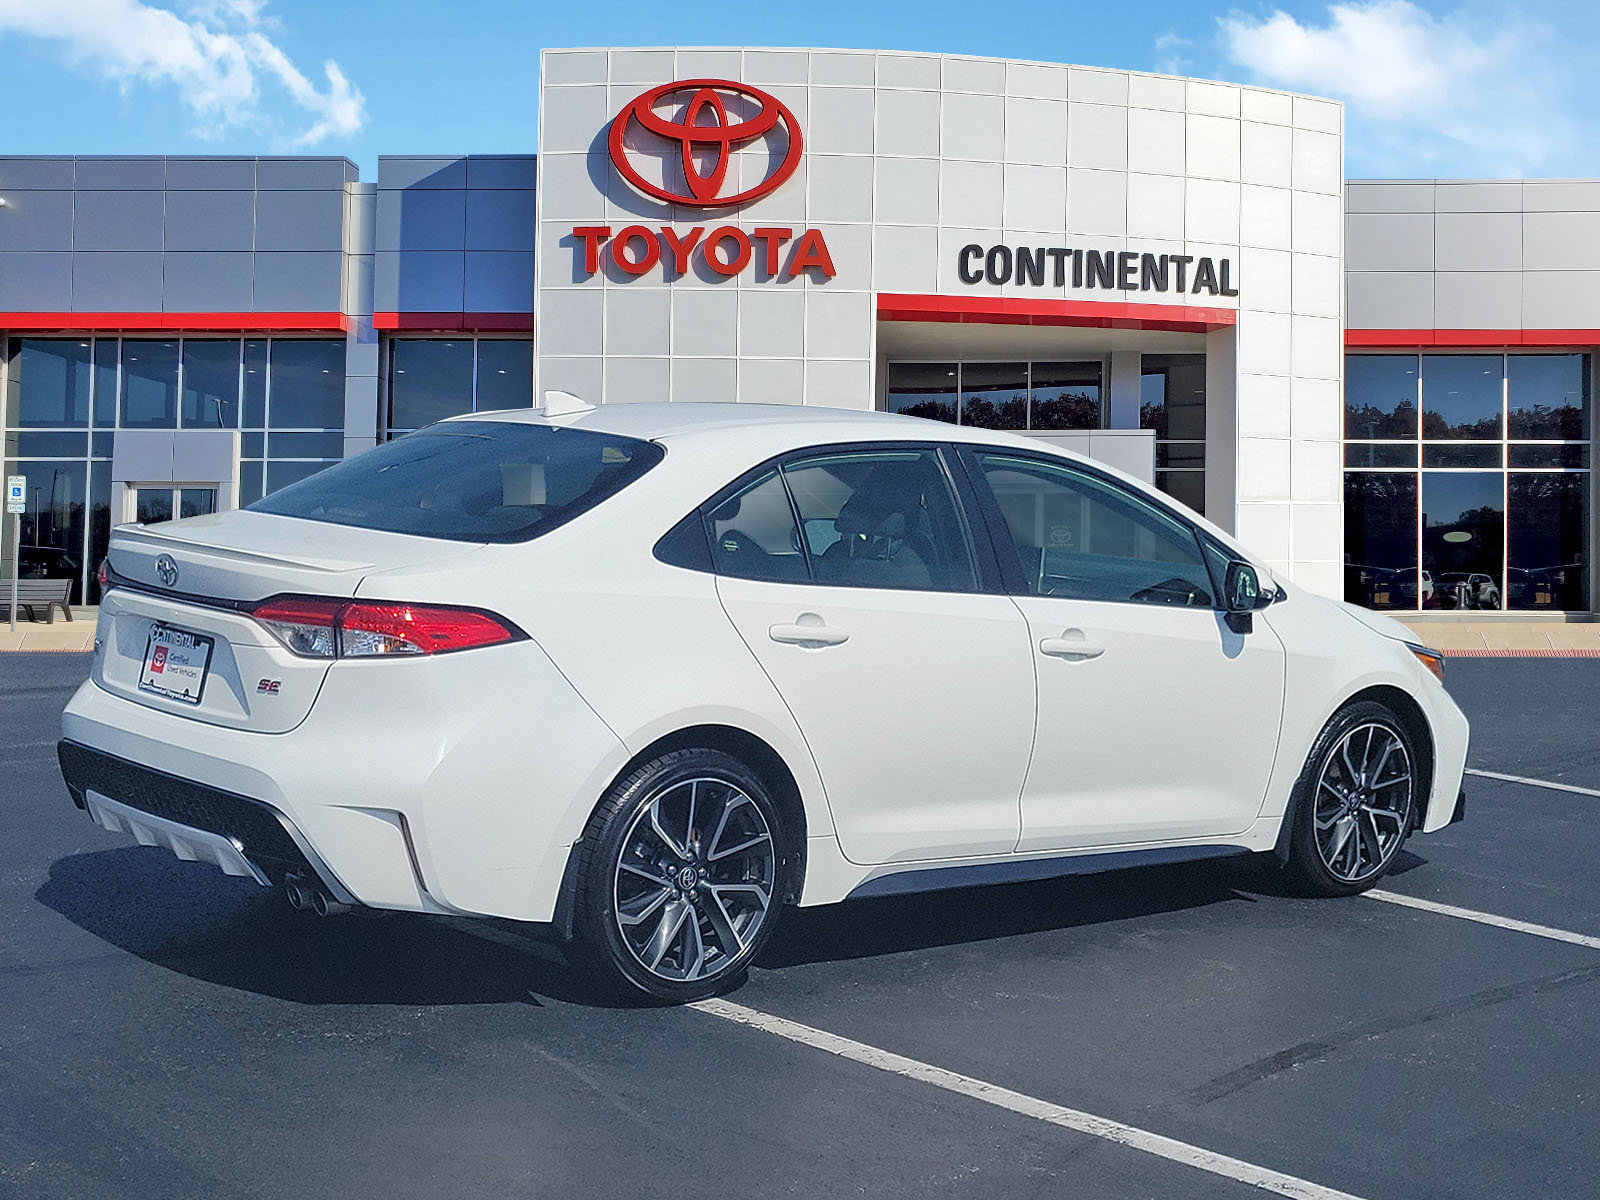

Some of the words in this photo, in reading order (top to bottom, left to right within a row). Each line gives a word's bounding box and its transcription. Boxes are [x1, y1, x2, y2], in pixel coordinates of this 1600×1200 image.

[572, 225, 837, 277] TOYOTA
[958, 244, 1239, 297] CONTINENTAL
[256, 678, 281, 694] SE
